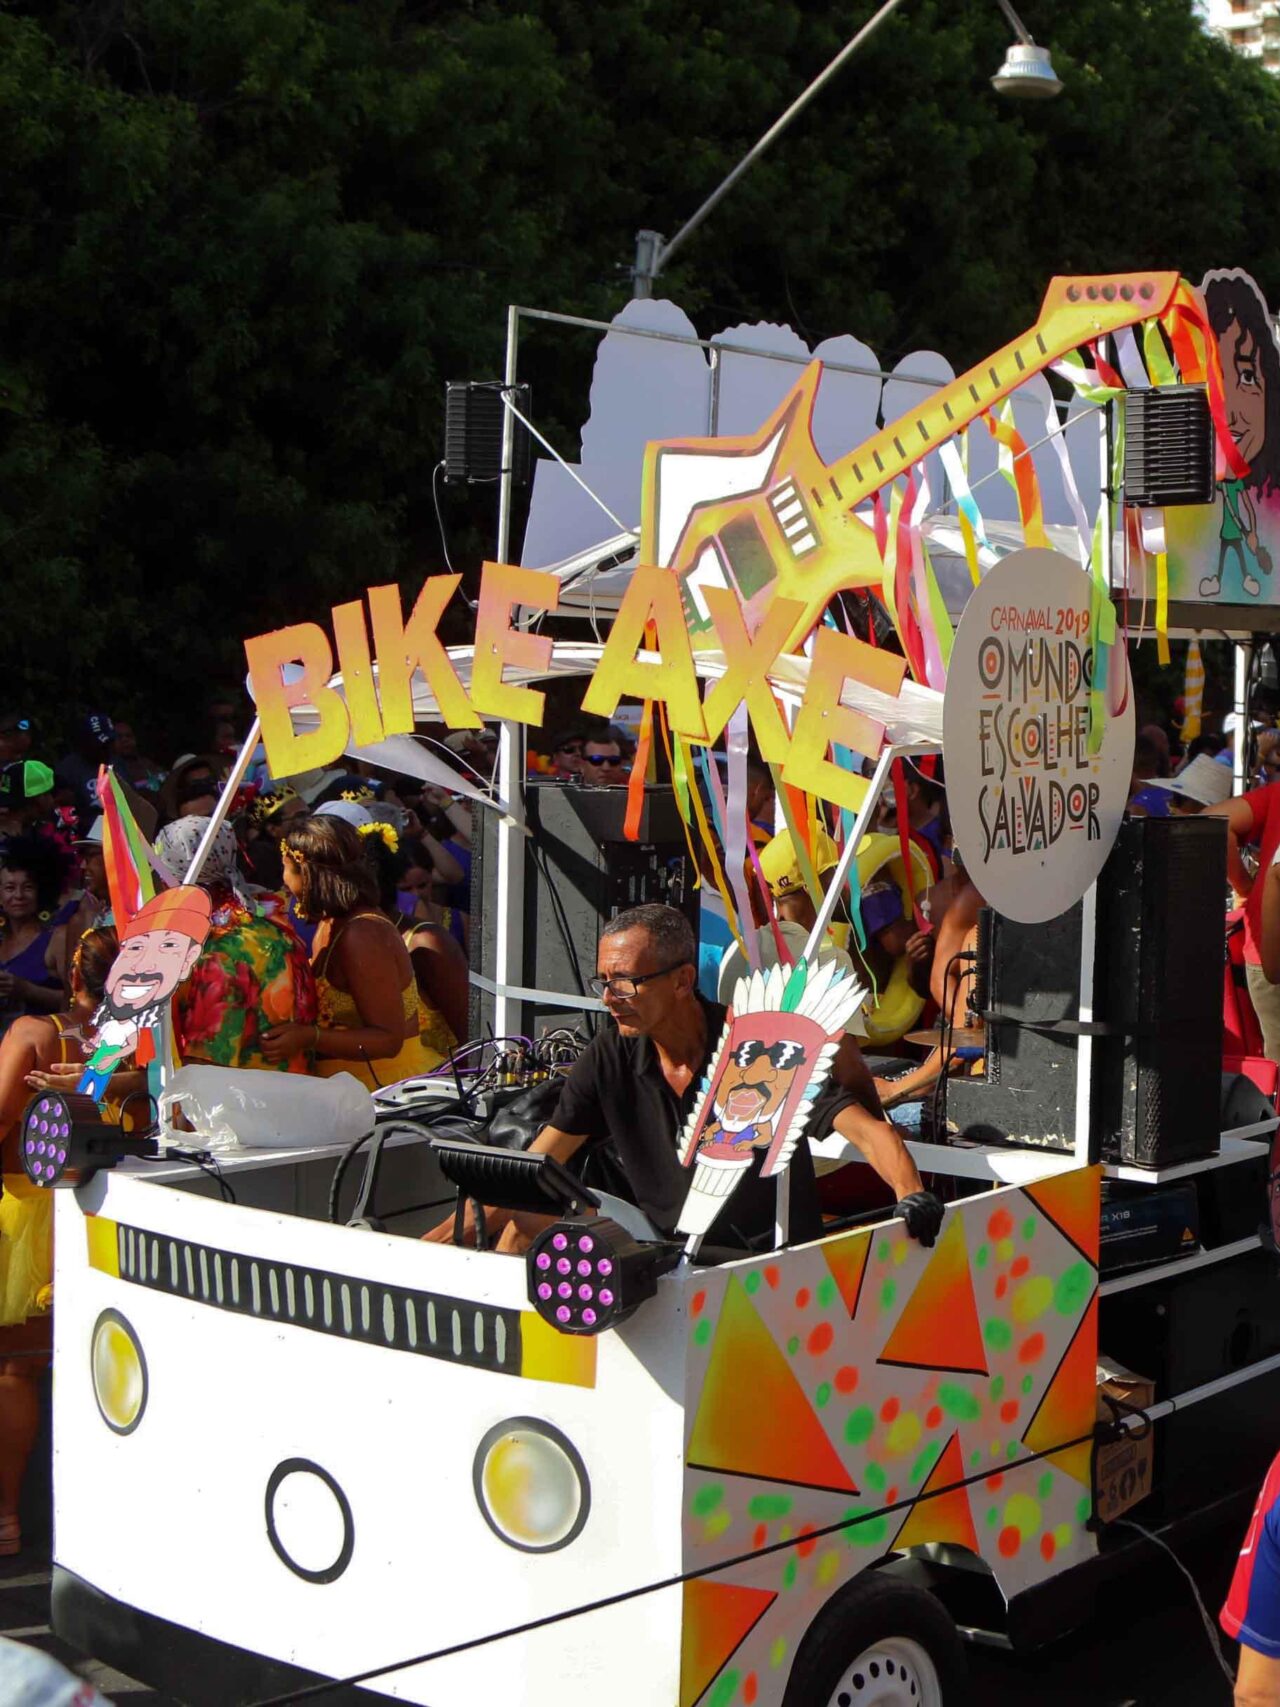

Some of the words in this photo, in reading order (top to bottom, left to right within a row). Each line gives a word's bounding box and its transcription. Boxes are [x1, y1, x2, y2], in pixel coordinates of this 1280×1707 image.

[991, 606, 1053, 632] CARNAVAL
[1056, 608, 1090, 639] 2019
[244, 560, 562, 780] BIKE
[580, 565, 908, 815] AXE
[978, 636, 1005, 699] O
[979, 702, 1090, 783] ESCOLHE
[978, 776, 1101, 864] SALVADOR
